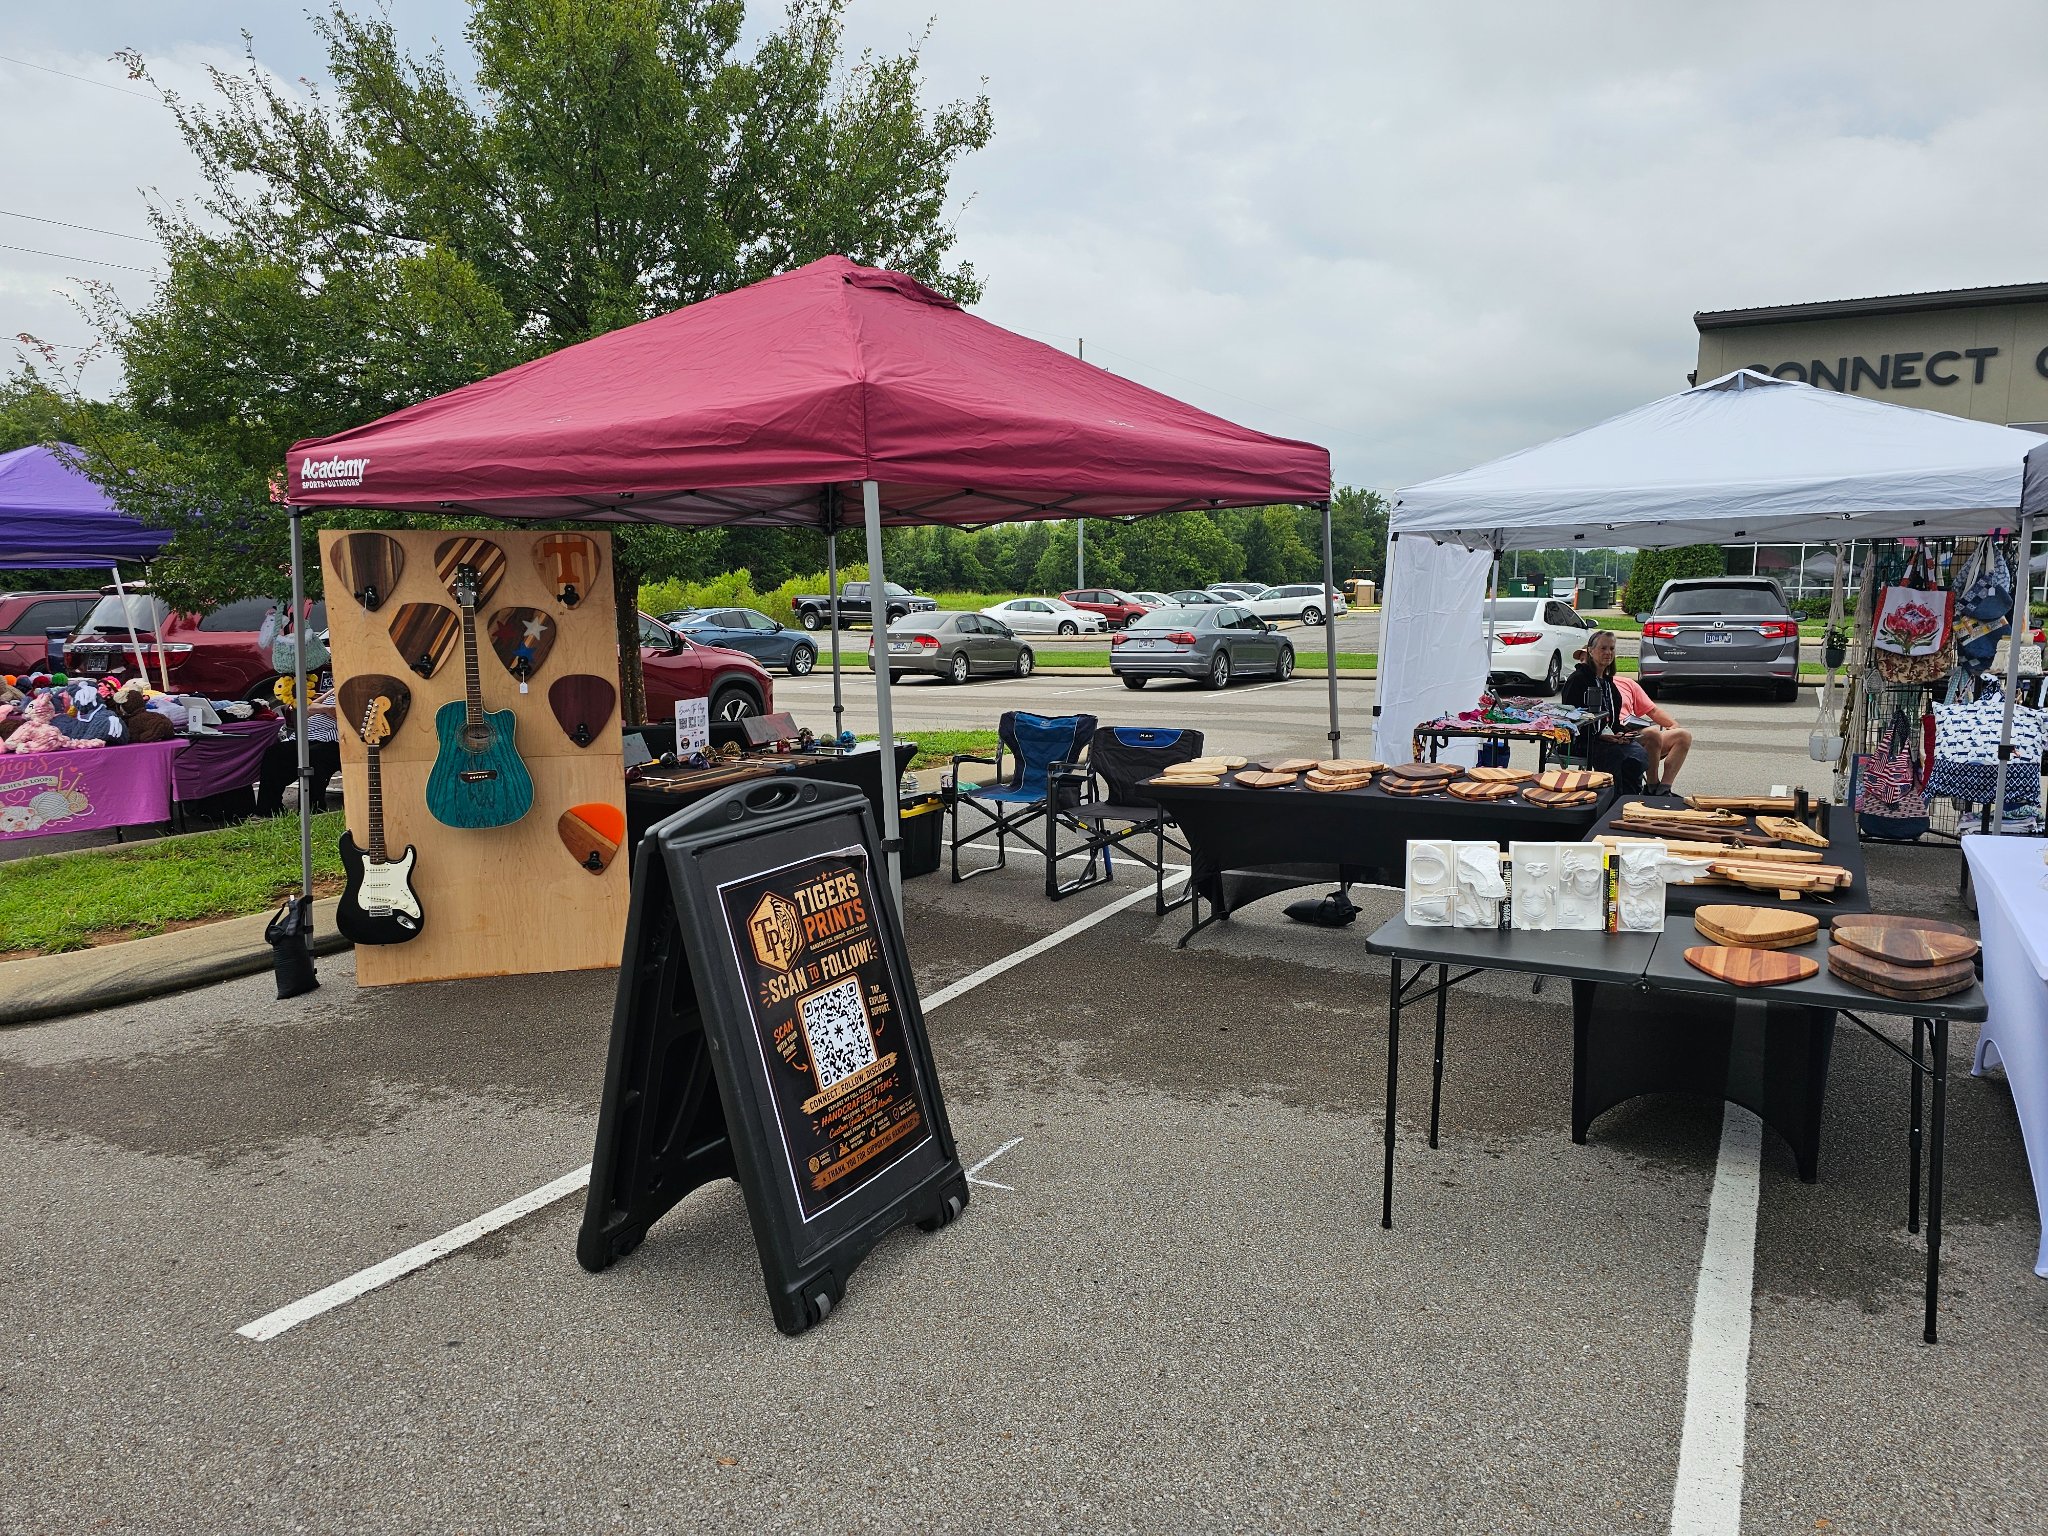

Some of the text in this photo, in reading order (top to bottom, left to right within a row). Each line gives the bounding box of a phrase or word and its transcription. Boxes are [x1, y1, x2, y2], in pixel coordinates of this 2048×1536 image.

[1746, 347, 1998, 393] ONNECT
[301, 455, 367, 482] Academy
[794, 872, 860, 916] TIGERS
[803, 898, 866, 942] PRINTS
[768, 938, 874, 1003] SCAN TO FOLLOW!
[773, 1018, 794, 1044] SCAN
[866, 1057, 892, 1078] DISCOVER
[821, 1090, 873, 1128] HANDCRAFTED
[874, 1078, 893, 1095] ITEMS
[827, 1165, 846, 1180] THANK
[845, 1156, 857, 1168] YOU
[857, 1151, 867, 1162] FOR
